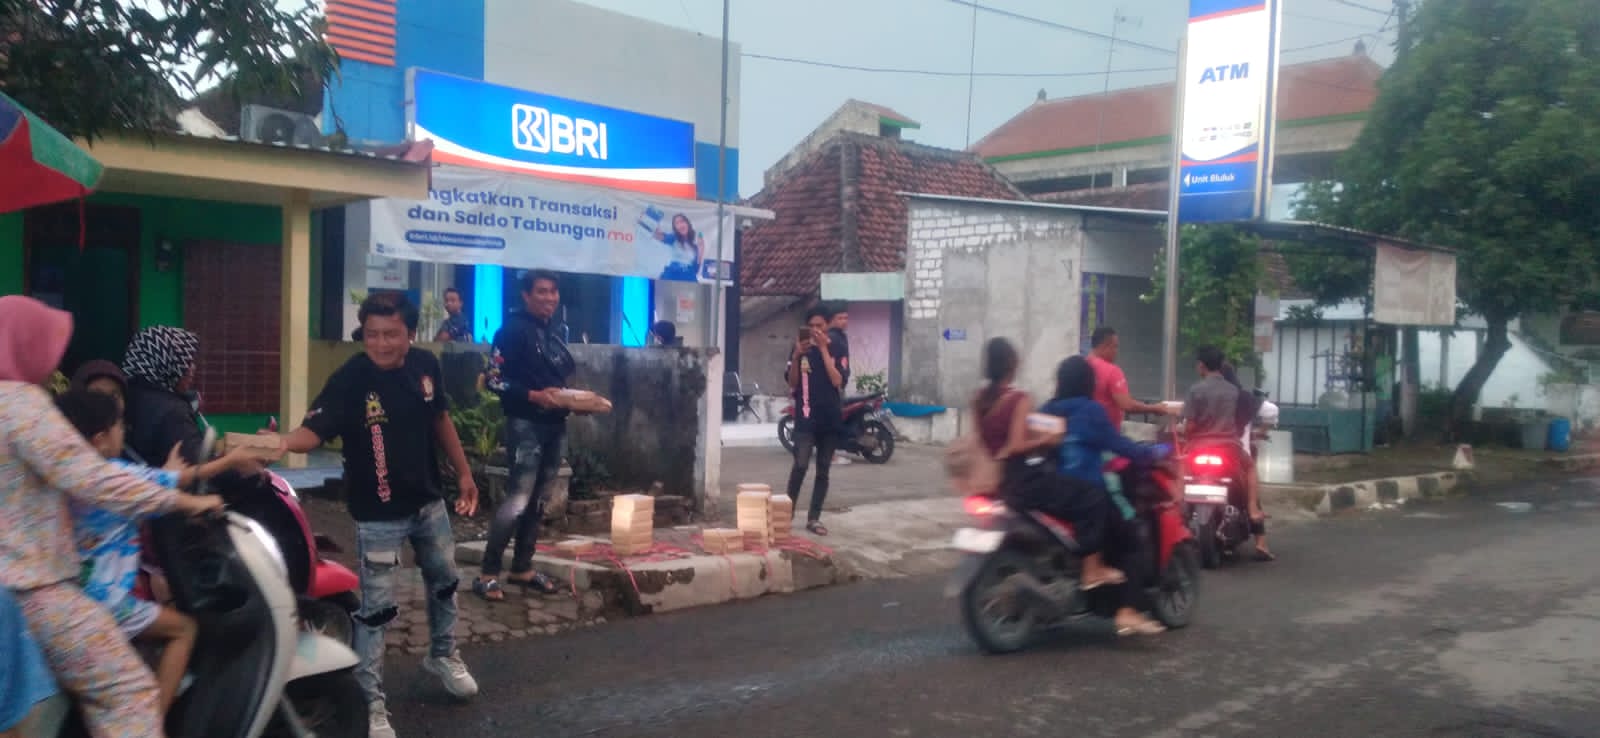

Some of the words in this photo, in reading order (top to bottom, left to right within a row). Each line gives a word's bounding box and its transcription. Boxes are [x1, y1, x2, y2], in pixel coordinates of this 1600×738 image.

[1199, 62, 1249, 84] ATM
[551, 113, 608, 160] BRI
[1191, 175, 1208, 184] Unit
[428, 187, 524, 208] ngkatkan
[528, 196, 617, 220] Transaksi
[408, 204, 450, 222] dan
[455, 210, 508, 229] Saldo
